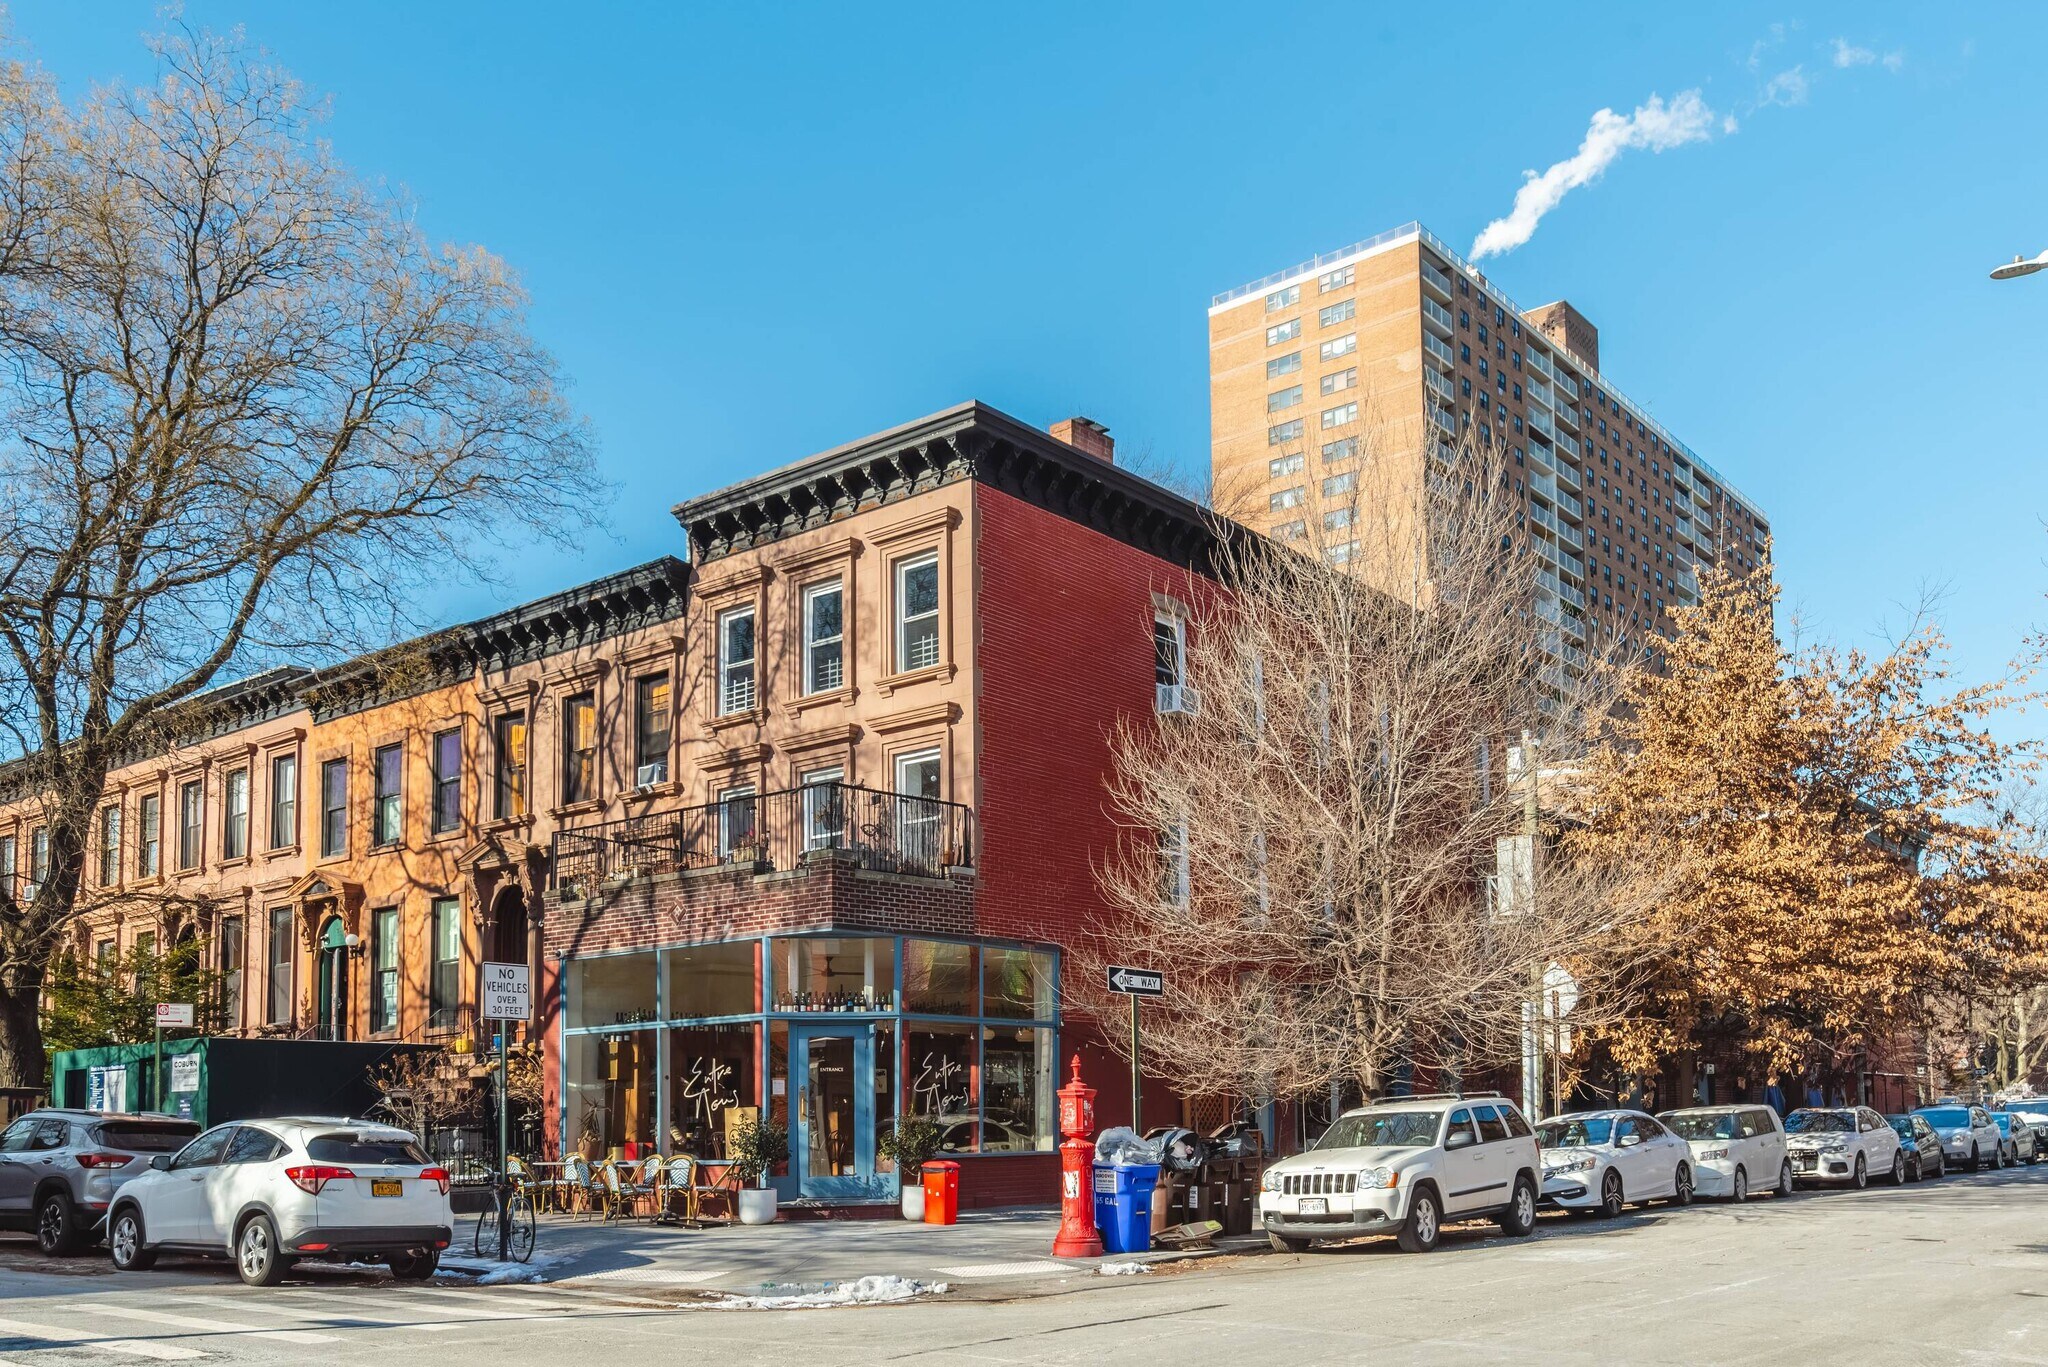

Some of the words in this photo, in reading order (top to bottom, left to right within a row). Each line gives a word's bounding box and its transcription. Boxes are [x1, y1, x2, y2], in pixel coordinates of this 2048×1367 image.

[498, 968, 515, 980] NO
[486, 981, 528, 993] VEHICLES
[1119, 975, 1134, 986] ONE
[1141, 977, 1157, 988] WAY
[497, 995, 517, 1004] OVER
[492, 1005, 503, 1014] 30
[505, 1006, 523, 1015] FEET
[174, 1060, 198, 1068] COBURN
[683, 1056, 732, 1098] Entre
[914, 1052, 962, 1093] Entre
